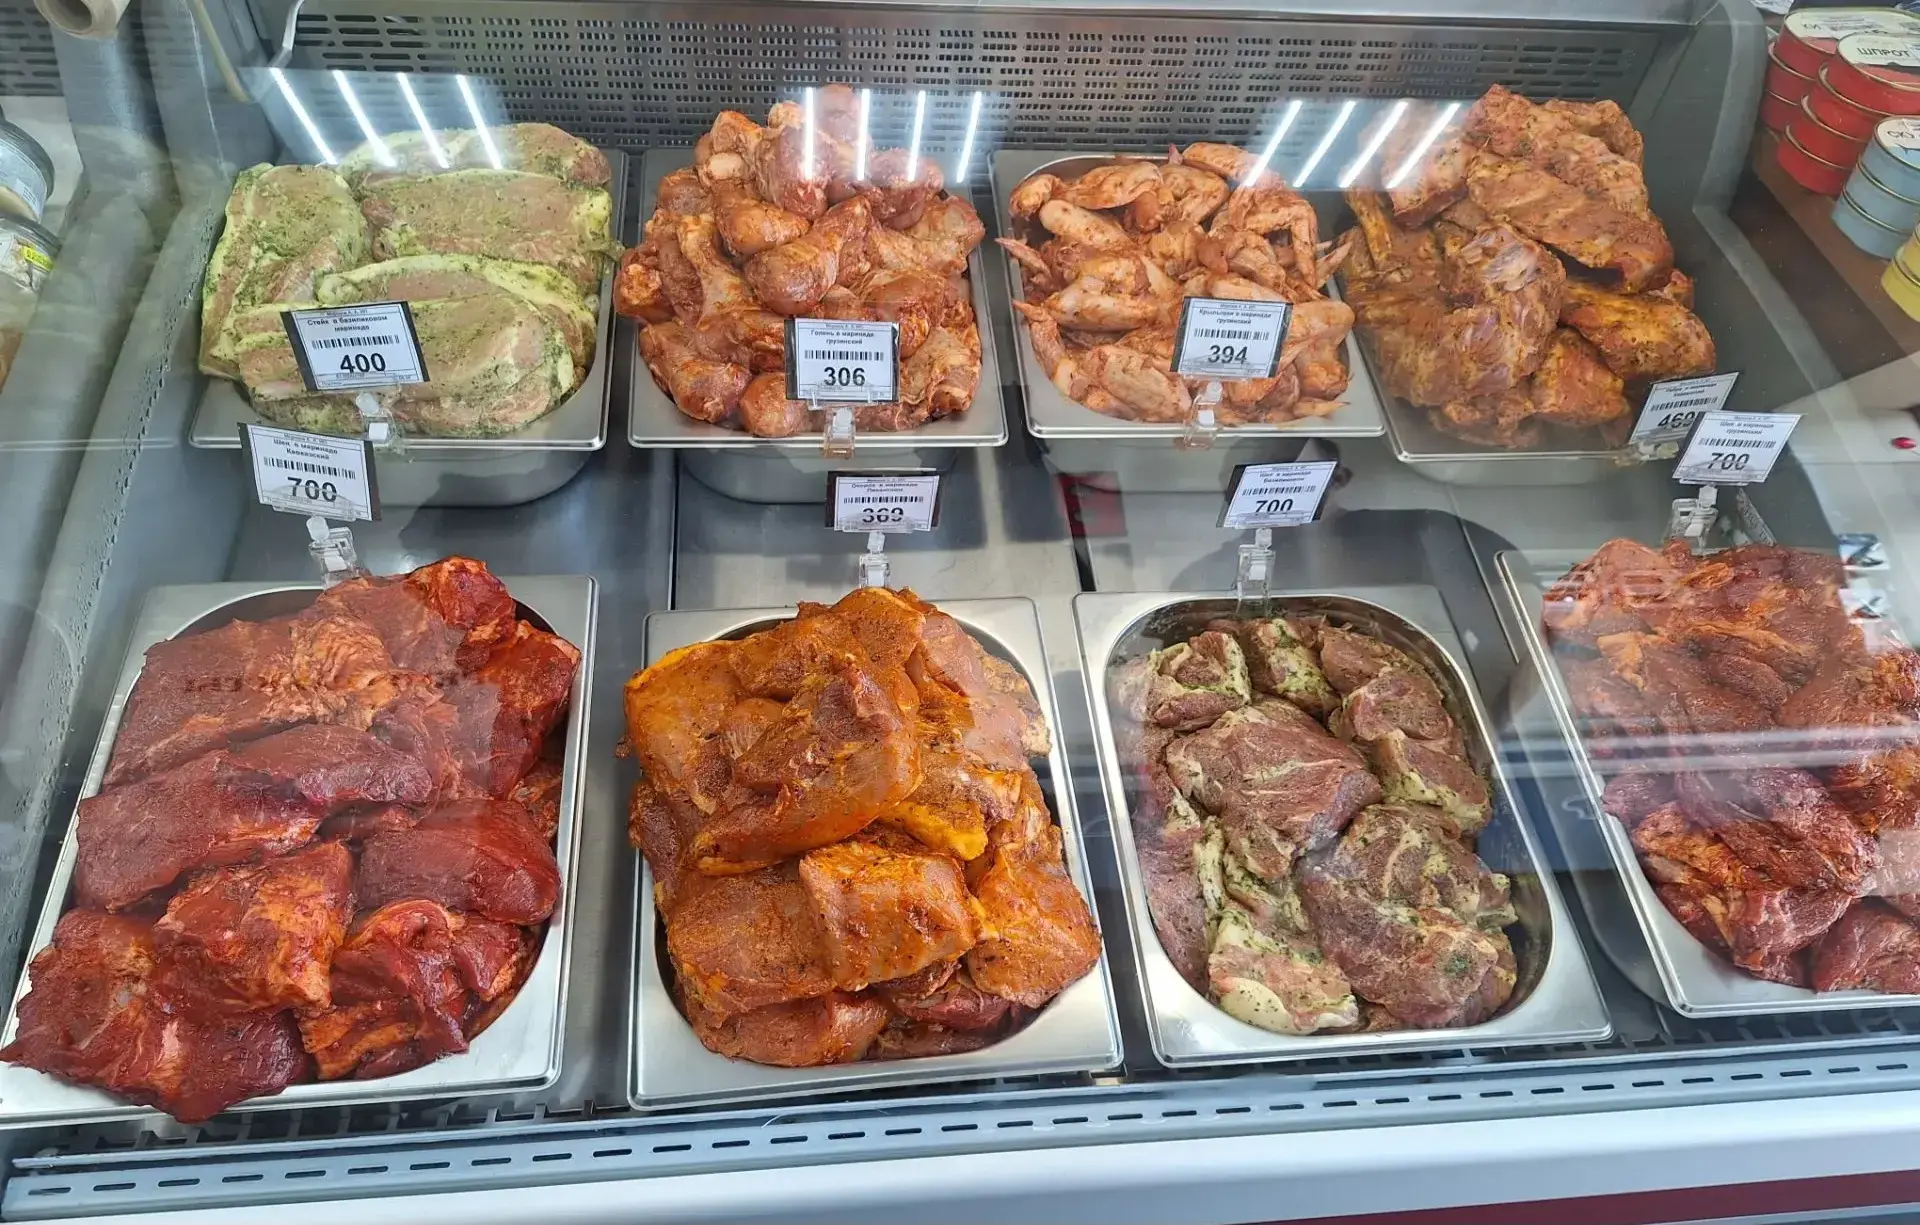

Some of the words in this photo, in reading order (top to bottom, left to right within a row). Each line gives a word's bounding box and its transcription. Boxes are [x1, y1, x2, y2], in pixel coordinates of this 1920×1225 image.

[340, 315, 388, 324] базиликовом
[810, 329, 835, 337] Голень
[826, 338, 863, 346] грузинский
[340, 352, 386, 374] 400
[1207, 345, 1248, 365] 394
[824, 366, 866, 387] 306
[1658, 411, 1696, 430] 469
[286, 448, 330, 460] Кавказский
[300, 443, 338, 455] маринаде
[1707, 452, 1751, 471] 700
[287, 476, 338, 503] 700
[862, 507, 904, 523] 369
[1255, 498, 1294, 516] 700
